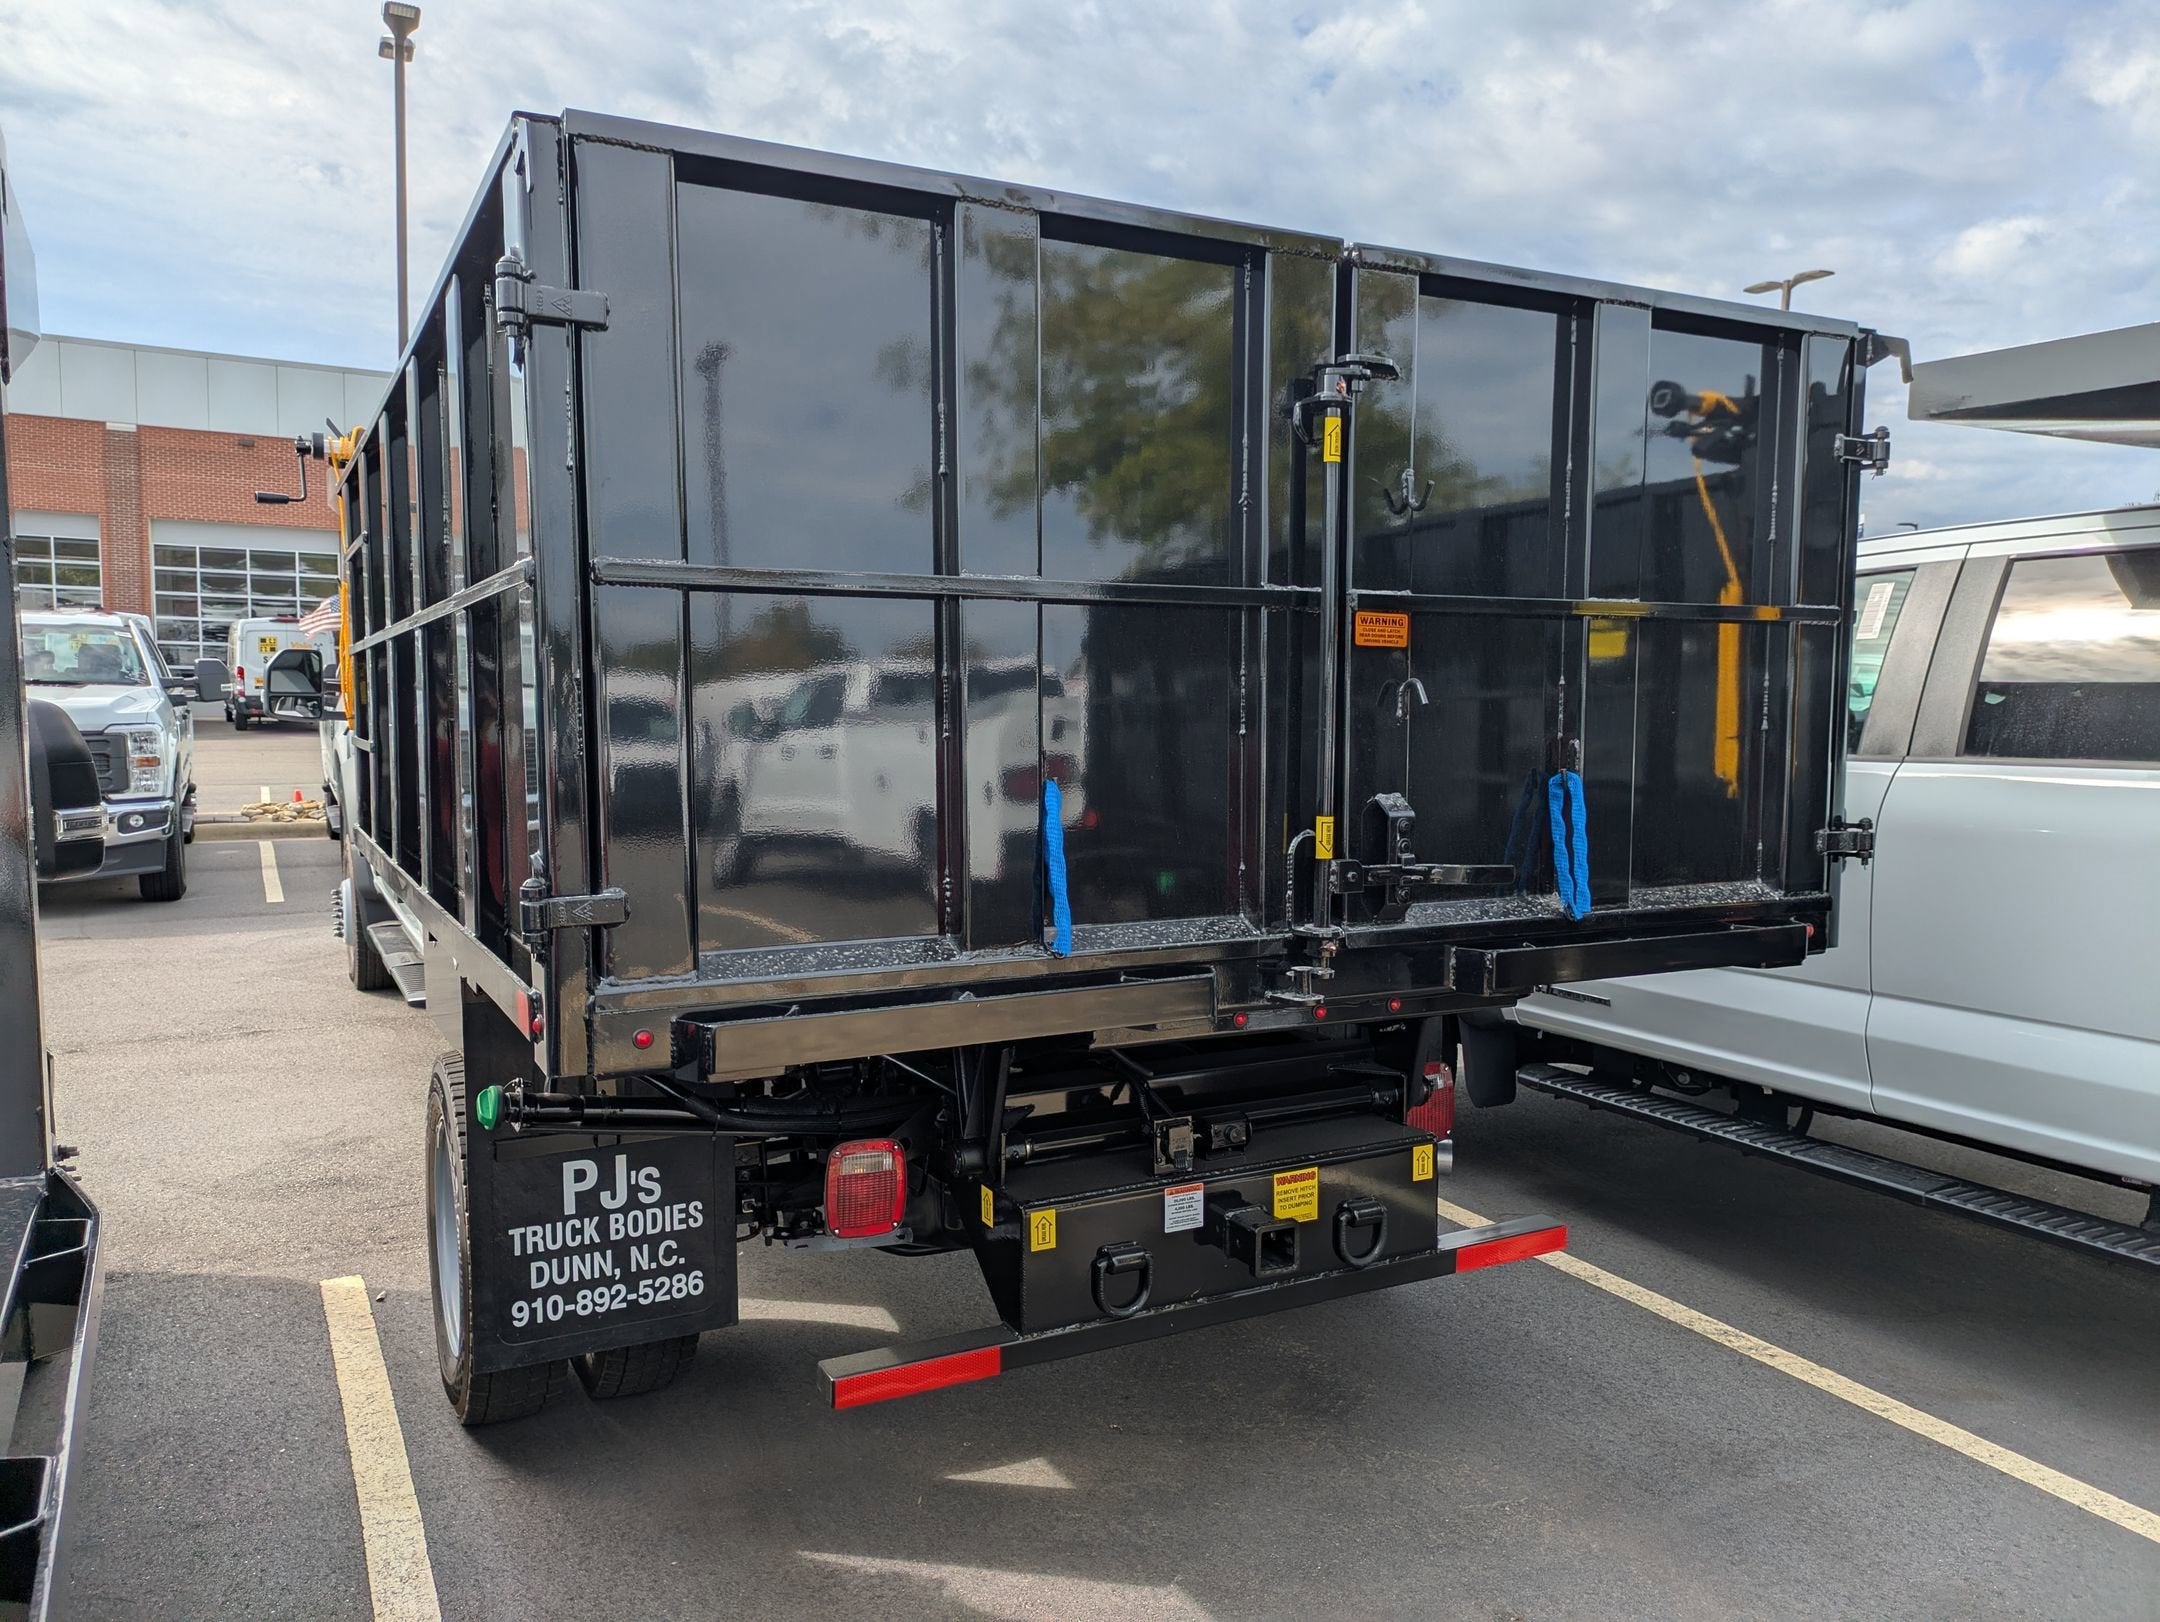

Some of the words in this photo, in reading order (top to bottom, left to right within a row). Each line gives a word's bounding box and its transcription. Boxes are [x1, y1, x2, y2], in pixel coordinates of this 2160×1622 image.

[1360, 616, 1404, 627] WARNING
[1276, 1171, 1316, 1186] WARNING
[1276, 1187, 1298, 1196] REMOVE
[1278, 1195, 1297, 1204] INSERT
[1298, 1192, 1315, 1200] PRIOR
[1288, 1200, 1312, 1209] DUMPING
[508, 1216, 600, 1256] TRUCK
[610, 1201, 703, 1240] BODIES
[531, 1250, 621, 1289] DUNN,
[631, 1240, 685, 1272] N.C.
[512, 1271, 704, 1327] 910-892-5286
